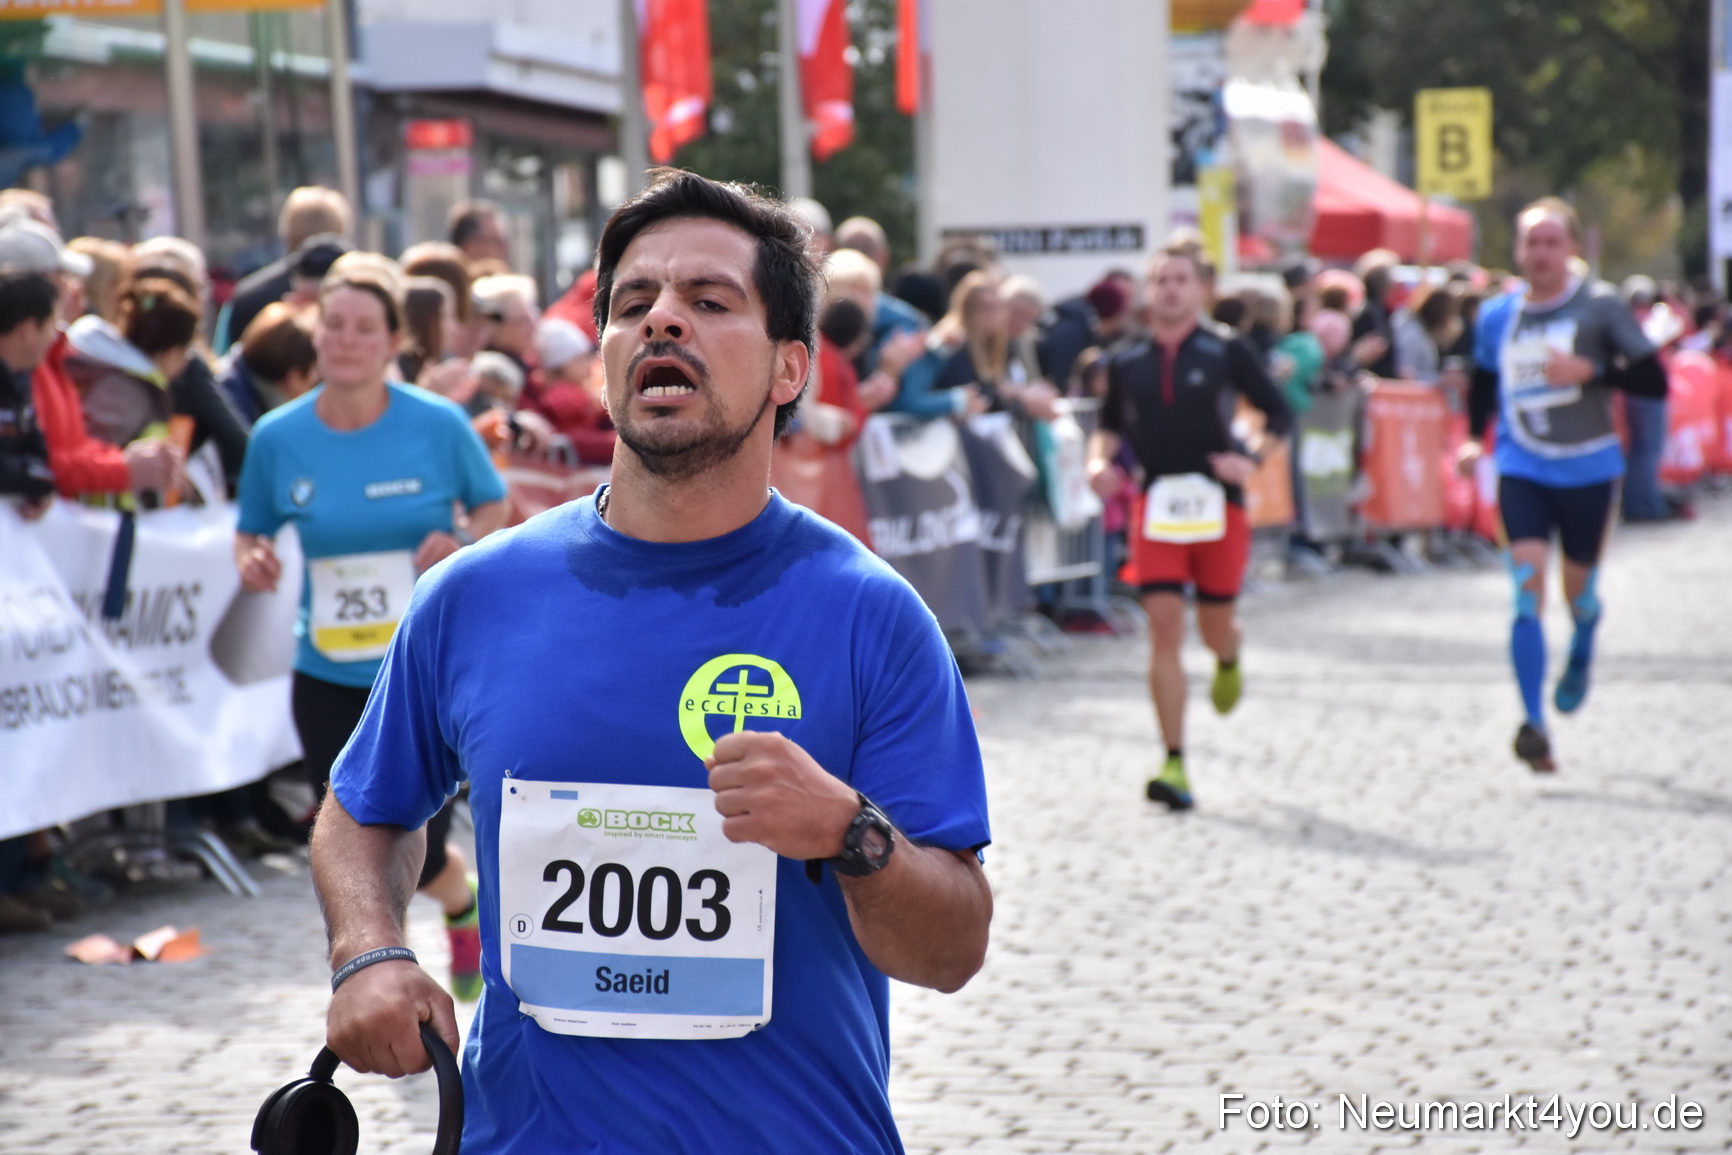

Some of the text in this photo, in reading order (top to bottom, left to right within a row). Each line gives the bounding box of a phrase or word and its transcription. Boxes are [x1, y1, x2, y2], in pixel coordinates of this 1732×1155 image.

[1437, 123, 1472, 175] B
[334, 586, 389, 621] 253
[685, 696, 797, 717] ecclesia
[604, 809, 697, 833] BOCK
[604, 830, 698, 842] inspired by smart concepts
[541, 858, 732, 942] 2003
[517, 920, 527, 934] D
[356, 950, 388, 965] Europe
[594, 966, 670, 995] Saeid
